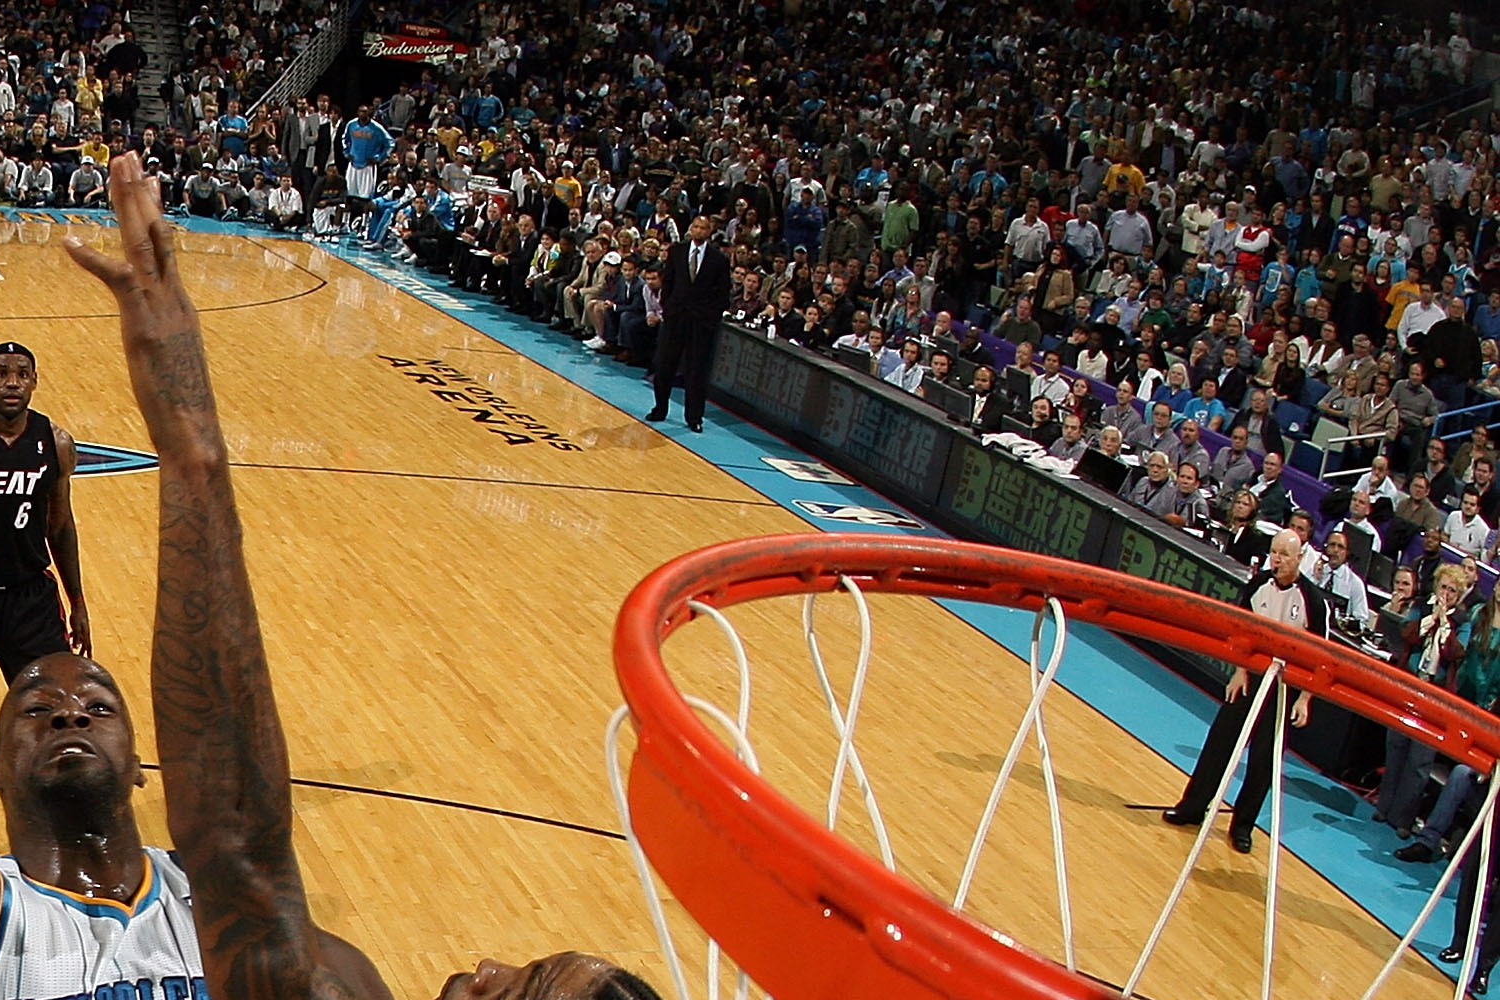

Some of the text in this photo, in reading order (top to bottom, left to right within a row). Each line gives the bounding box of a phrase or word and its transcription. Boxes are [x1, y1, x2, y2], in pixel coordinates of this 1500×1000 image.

[365, 41, 454, 58] Budweiser
[377, 353, 536, 446] ARENA
[417, 357, 584, 452] NEW ORLEANS
[14, 501, 31, 529] 6
